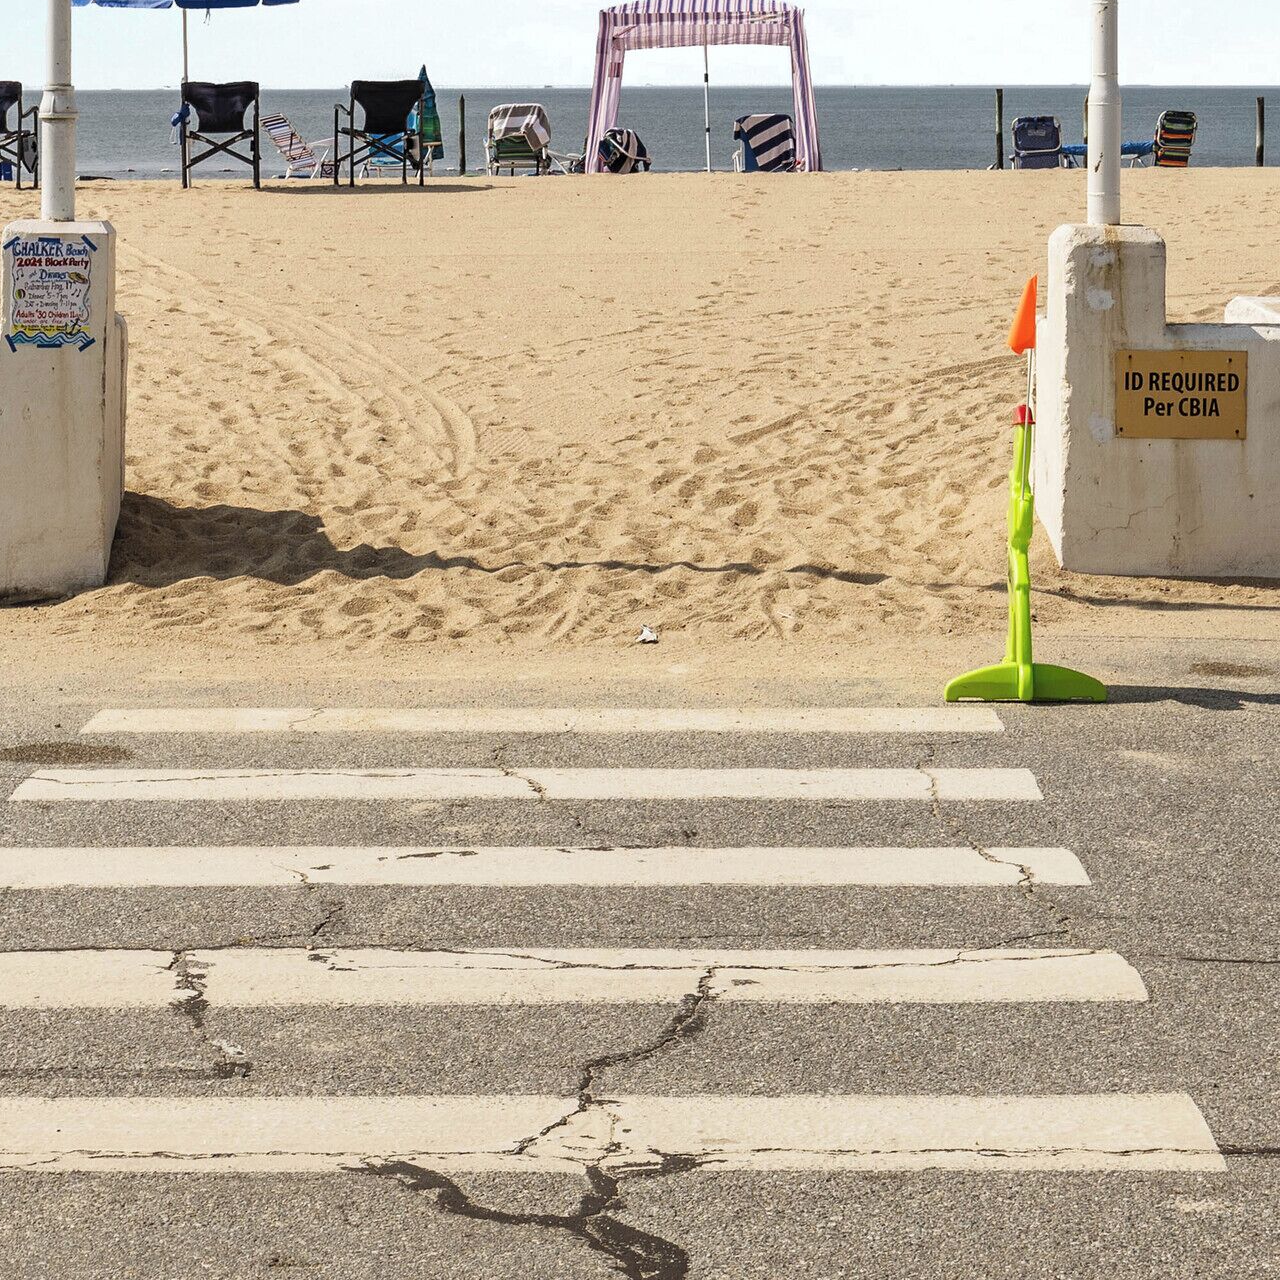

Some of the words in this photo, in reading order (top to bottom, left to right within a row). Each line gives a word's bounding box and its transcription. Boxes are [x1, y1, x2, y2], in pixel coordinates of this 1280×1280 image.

[16, 257, 42, 267] 2024
[1124, 372, 1144, 391] ID
[1148, 371, 1240, 393] REQUIRED
[1144, 397, 1174, 417] Per
[1178, 397, 1221, 417] CBIA
